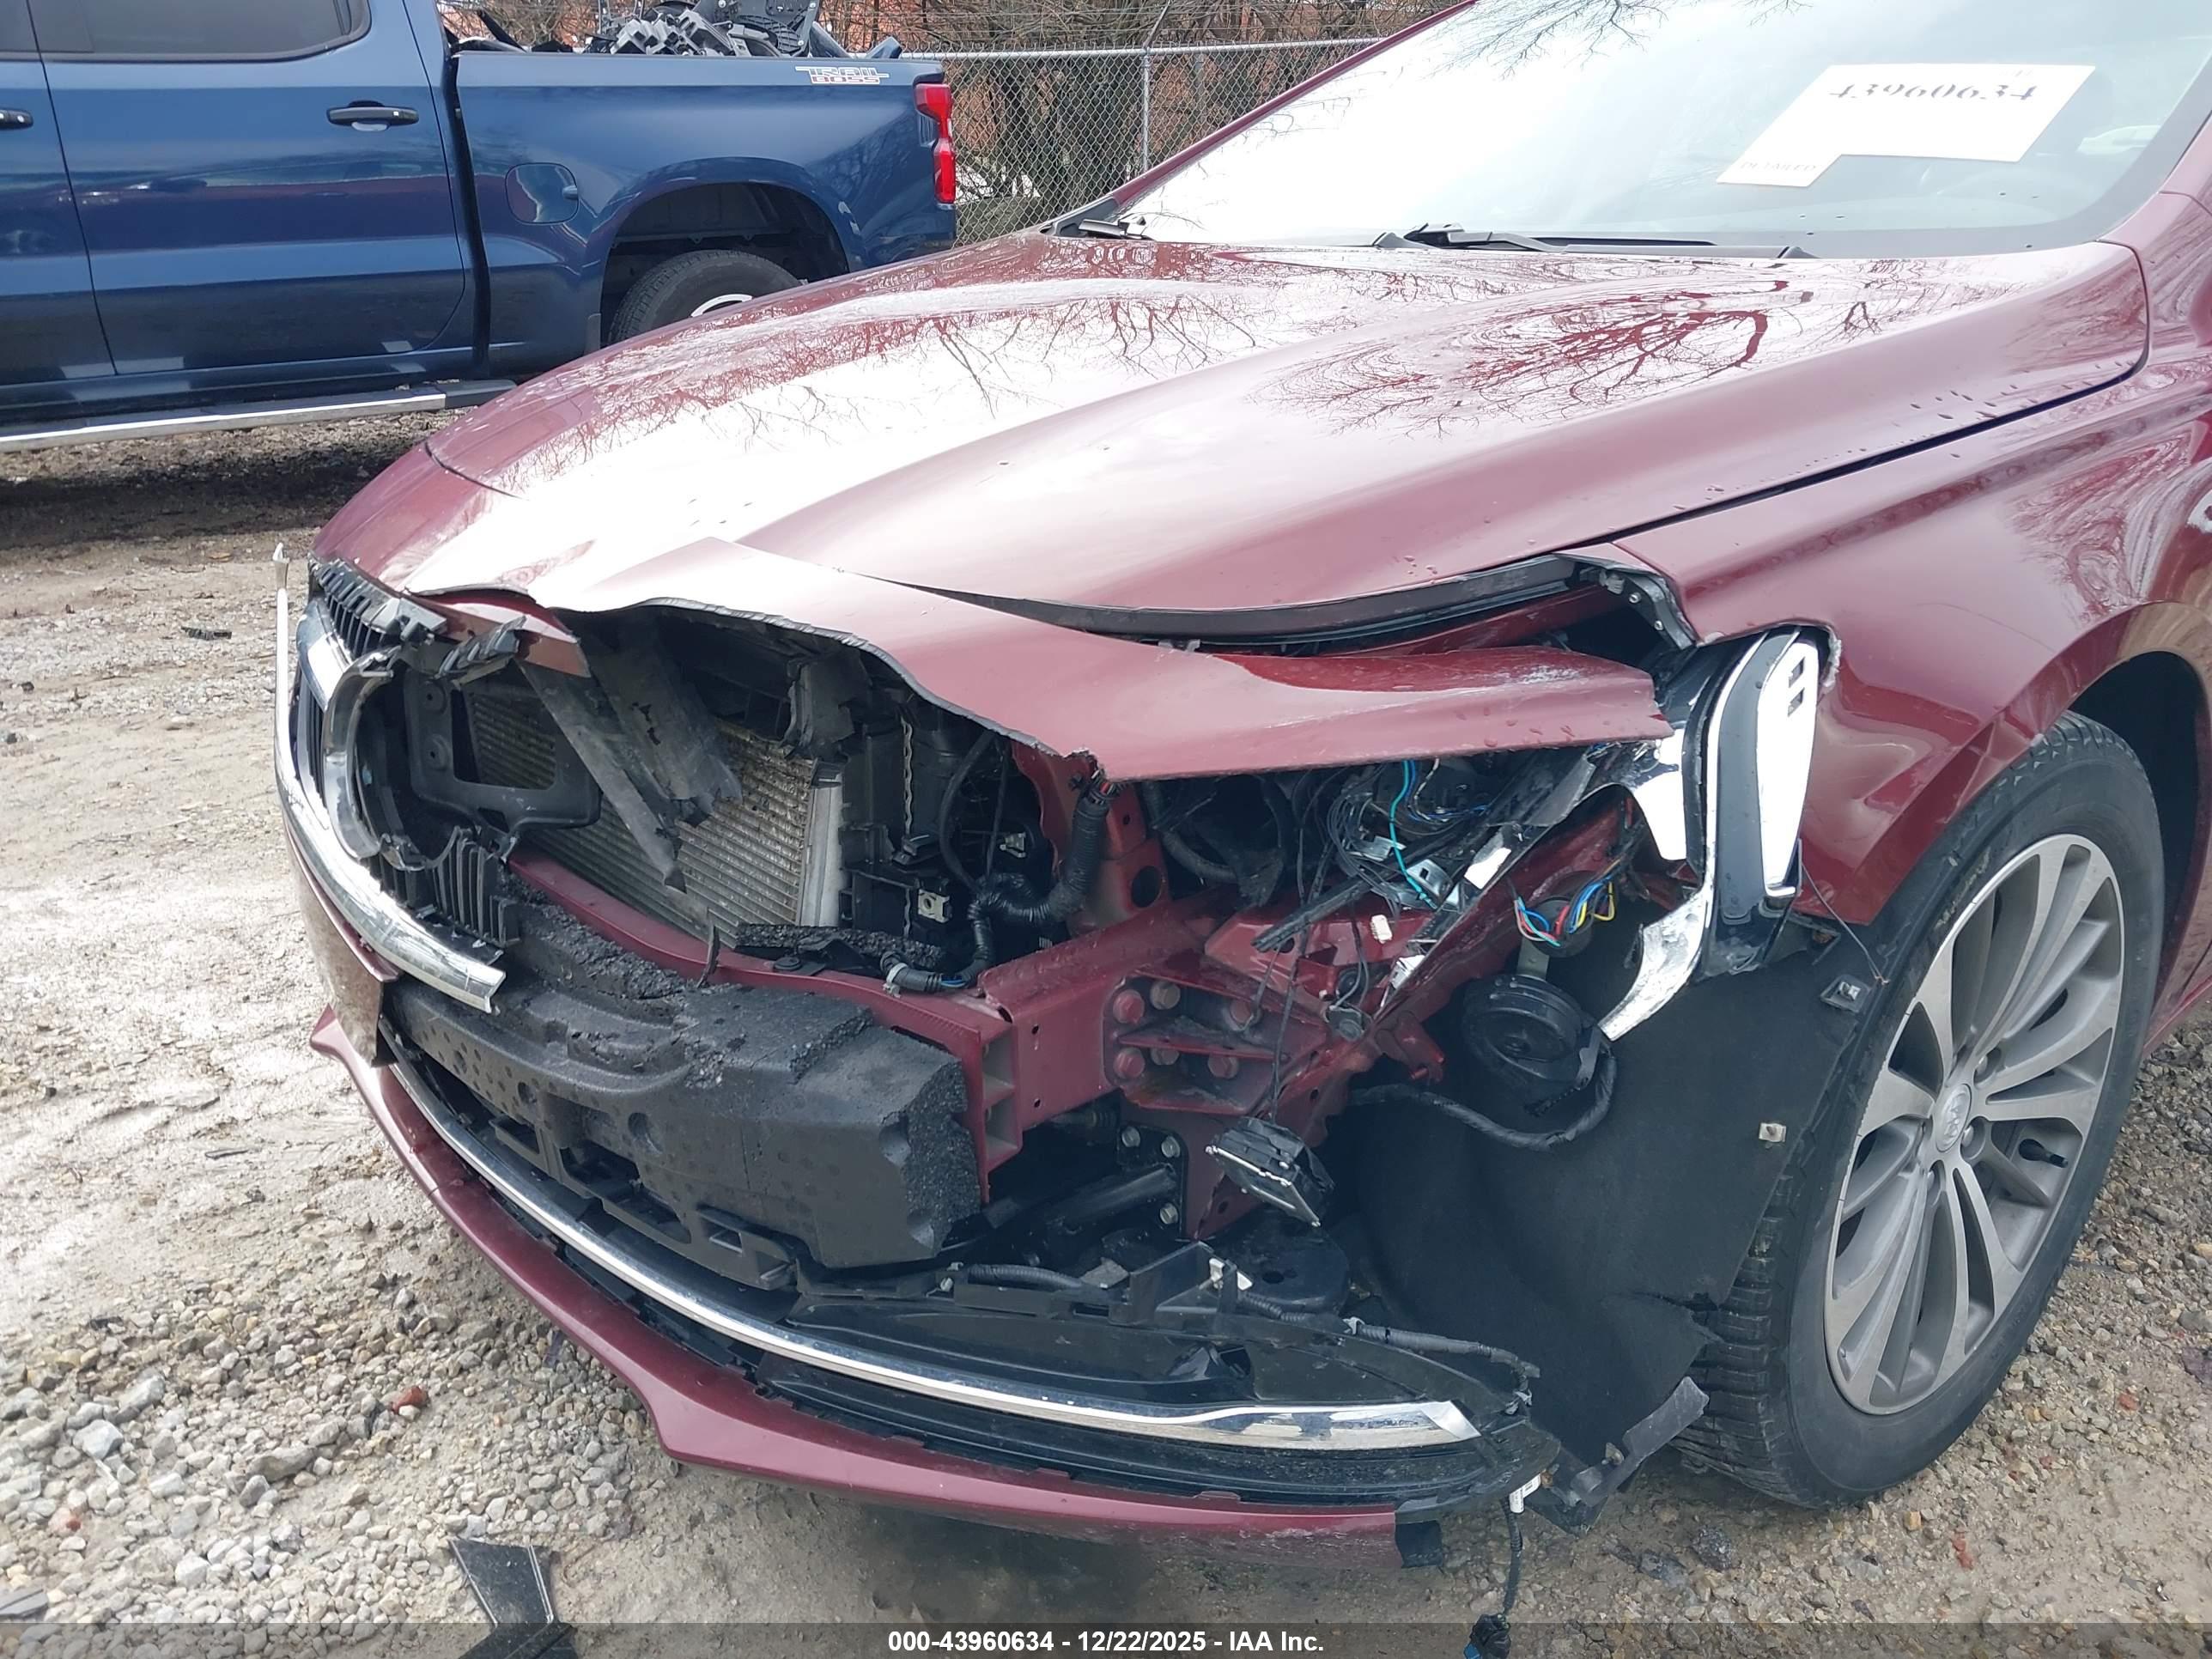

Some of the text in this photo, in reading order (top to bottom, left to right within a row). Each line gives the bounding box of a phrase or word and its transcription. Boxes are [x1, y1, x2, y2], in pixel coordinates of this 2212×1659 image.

[795, 66, 890, 78] TRAIL
[811, 76, 881, 85] BOSS
[1828, 83, 2039, 101] 43960634
